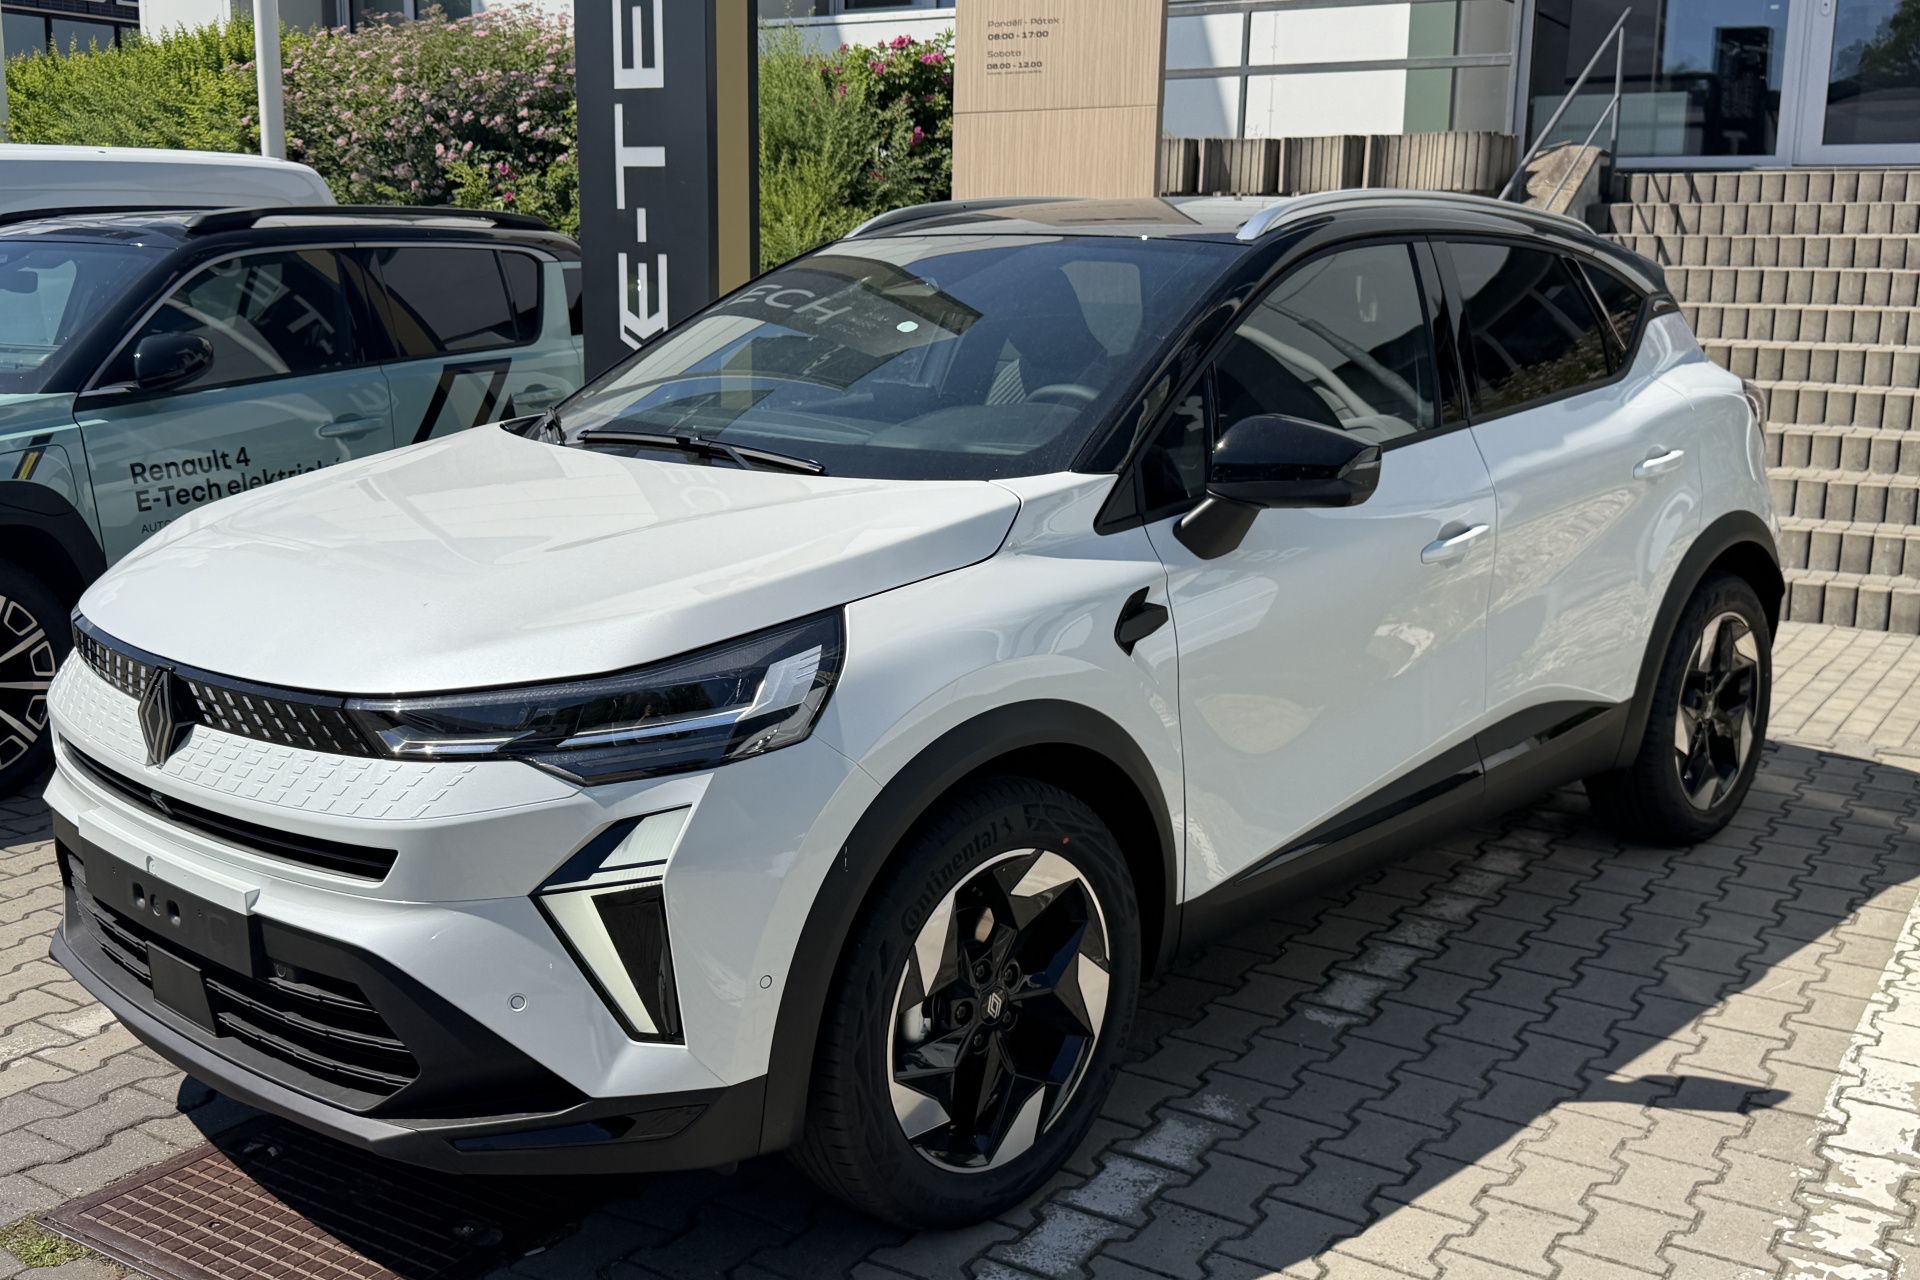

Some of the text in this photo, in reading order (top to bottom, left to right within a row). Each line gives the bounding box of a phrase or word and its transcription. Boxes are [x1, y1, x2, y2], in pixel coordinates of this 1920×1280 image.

[986, 50, 1022, 58] Sobota
[129, 446, 251, 485] Renault 4
[135, 478, 222, 513] E-Tech
[899, 820, 1000, 936] Continental
